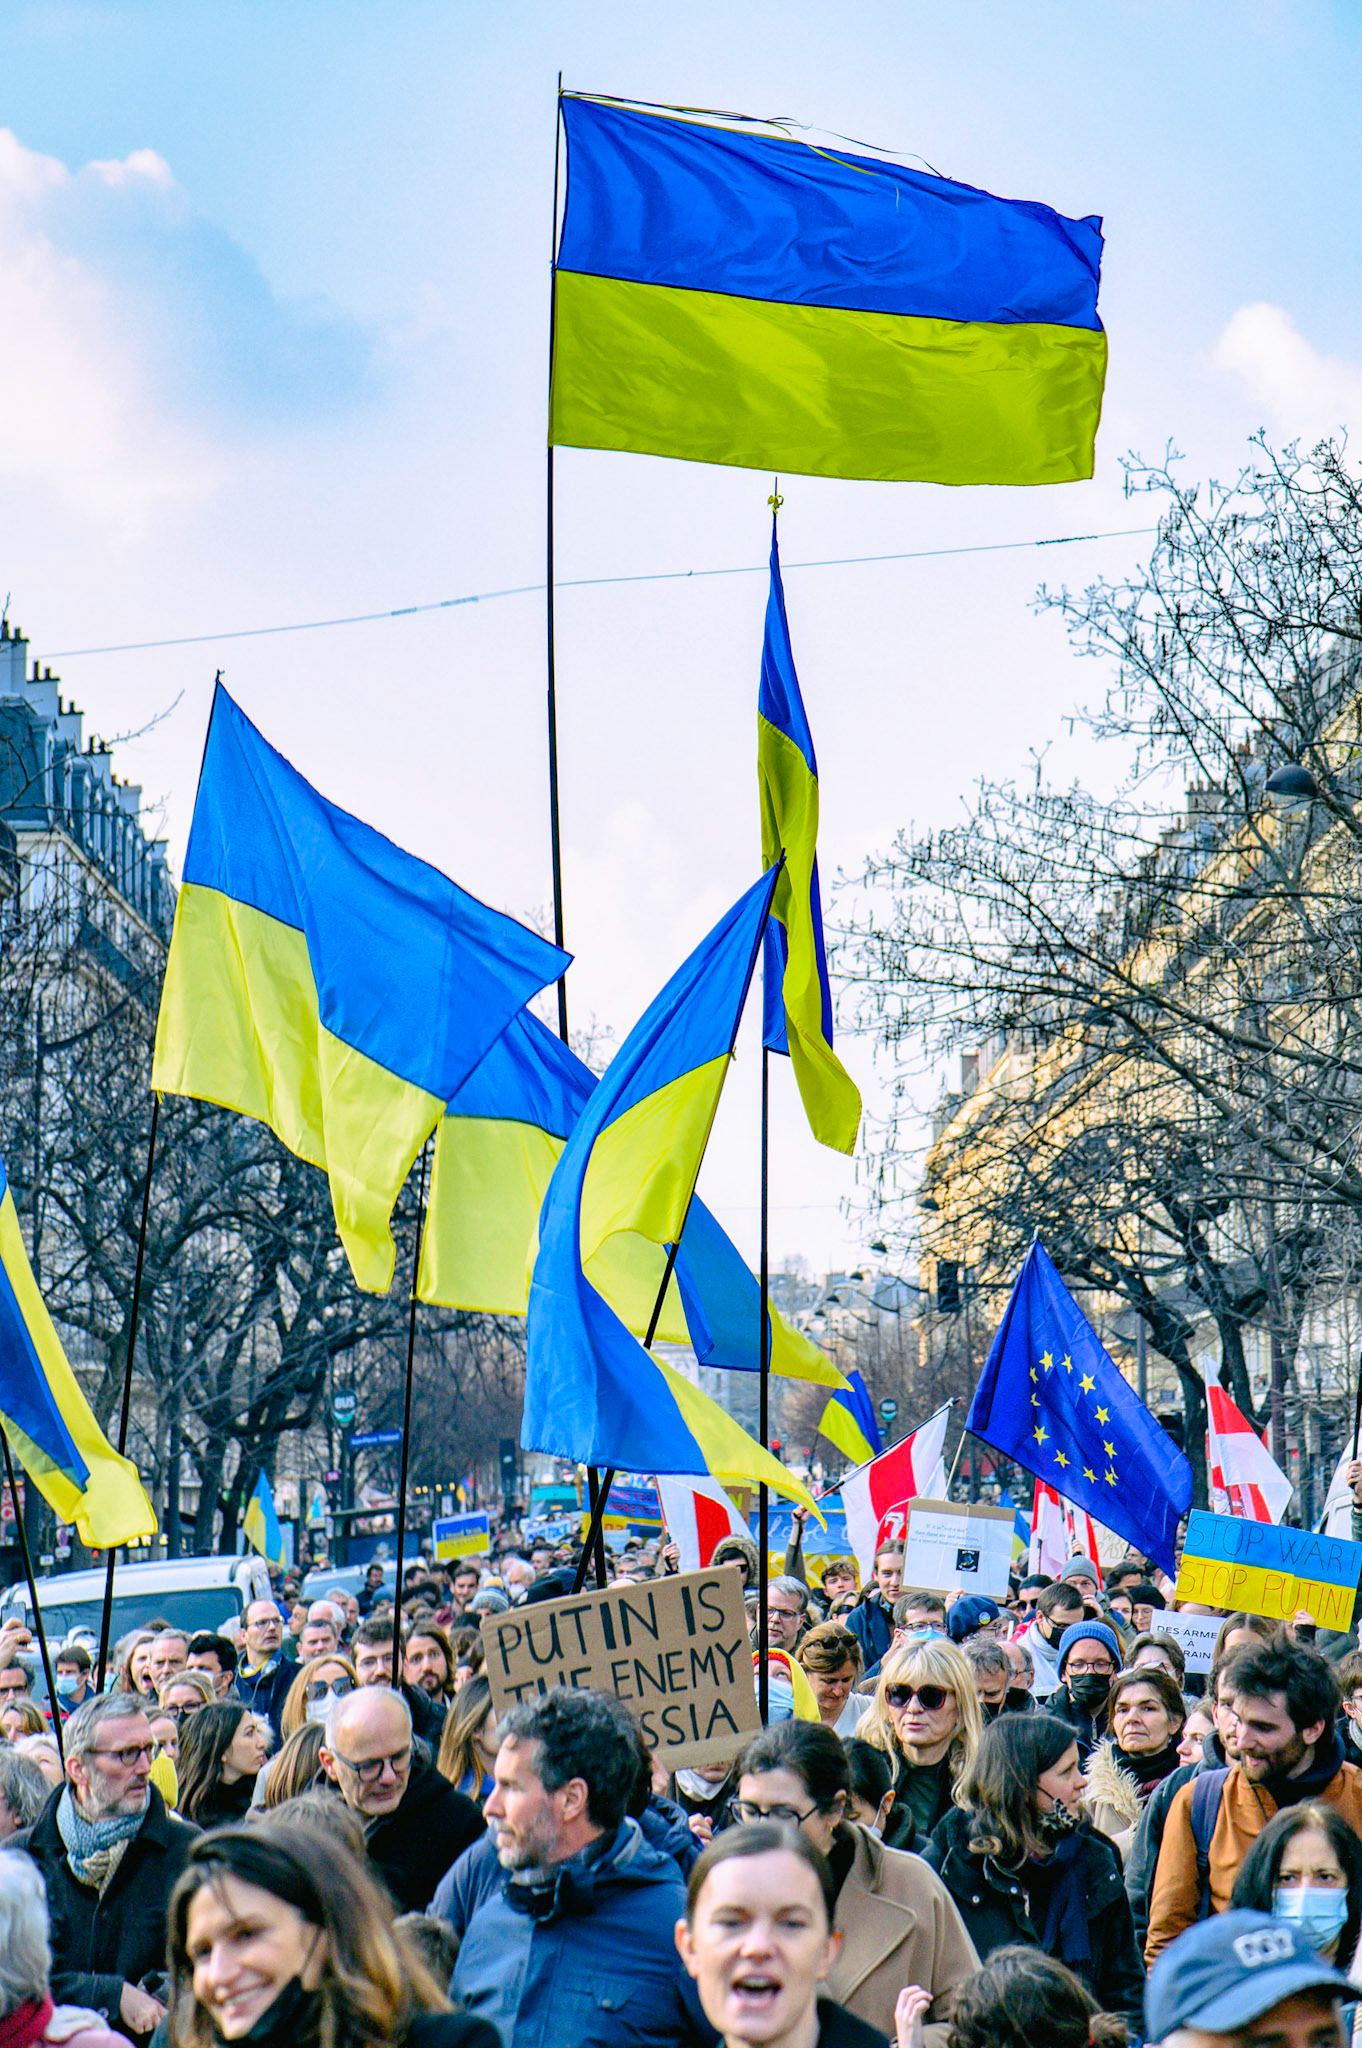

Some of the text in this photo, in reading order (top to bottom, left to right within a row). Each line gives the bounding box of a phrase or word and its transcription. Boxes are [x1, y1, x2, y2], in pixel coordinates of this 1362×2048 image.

[334, 1395, 356, 1410] BUS
[1187, 1516, 1357, 1573] STOP WAR!
[1176, 1561, 1351, 1624] STOP PUTIN!
[497, 1581, 725, 1676] PUTIN IS
[1156, 1625, 1218, 1639] DES ARME
[611, 1639, 742, 1700] ENEMY
[640, 1698, 739, 1749] SSIA
